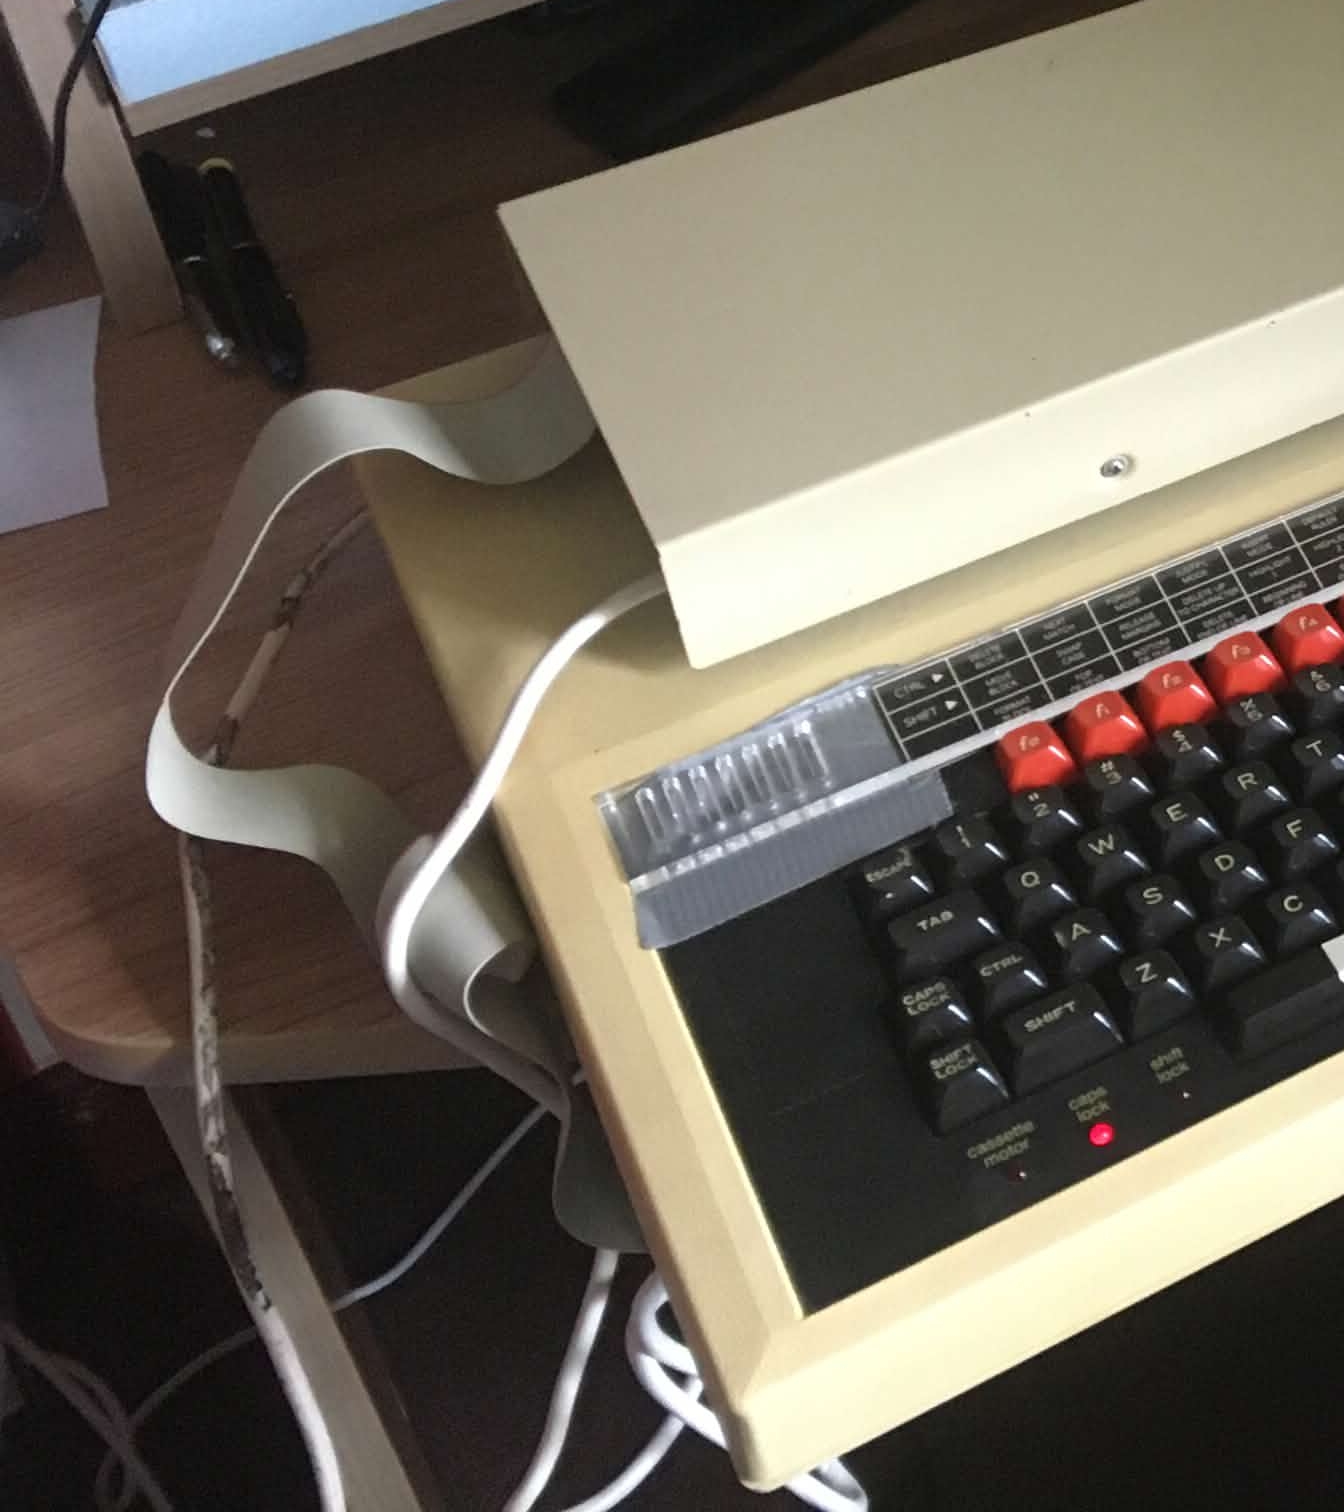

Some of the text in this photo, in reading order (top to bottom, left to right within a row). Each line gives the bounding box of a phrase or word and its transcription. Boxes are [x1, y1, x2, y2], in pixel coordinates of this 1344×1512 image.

[1305, 740, 1325, 757] T
[1236, 771, 1258, 791] R
[1166, 802, 1187, 822] E
[1286, 819, 1304, 838] F
[1088, 834, 1116, 855] W
[1214, 854, 1235, 872] D
[1020, 871, 1041, 888] Q
[1142, 887, 1163, 905] S
[1283, 895, 1303, 913] C
[1071, 922, 1092, 941] A
[1209, 927, 1232, 948] X
[979, 954, 1024, 978] CTRL
[1135, 962, 1158, 983] Z
[903, 982, 946, 1006] CAPS
[906, 992, 951, 1017] LOCK
[1024, 1000, 1076, 1033] SHIFT
[930, 1043, 973, 1071] SHIFT
[934, 1055, 979, 1080] LOCK
[1155, 1061, 1191, 1084] lock
[1068, 1085, 1109, 1112] caps
[1076, 1100, 1112, 1123] lock
[966, 1120, 1036, 1159] cassette
[983, 1138, 1030, 1169] motor
